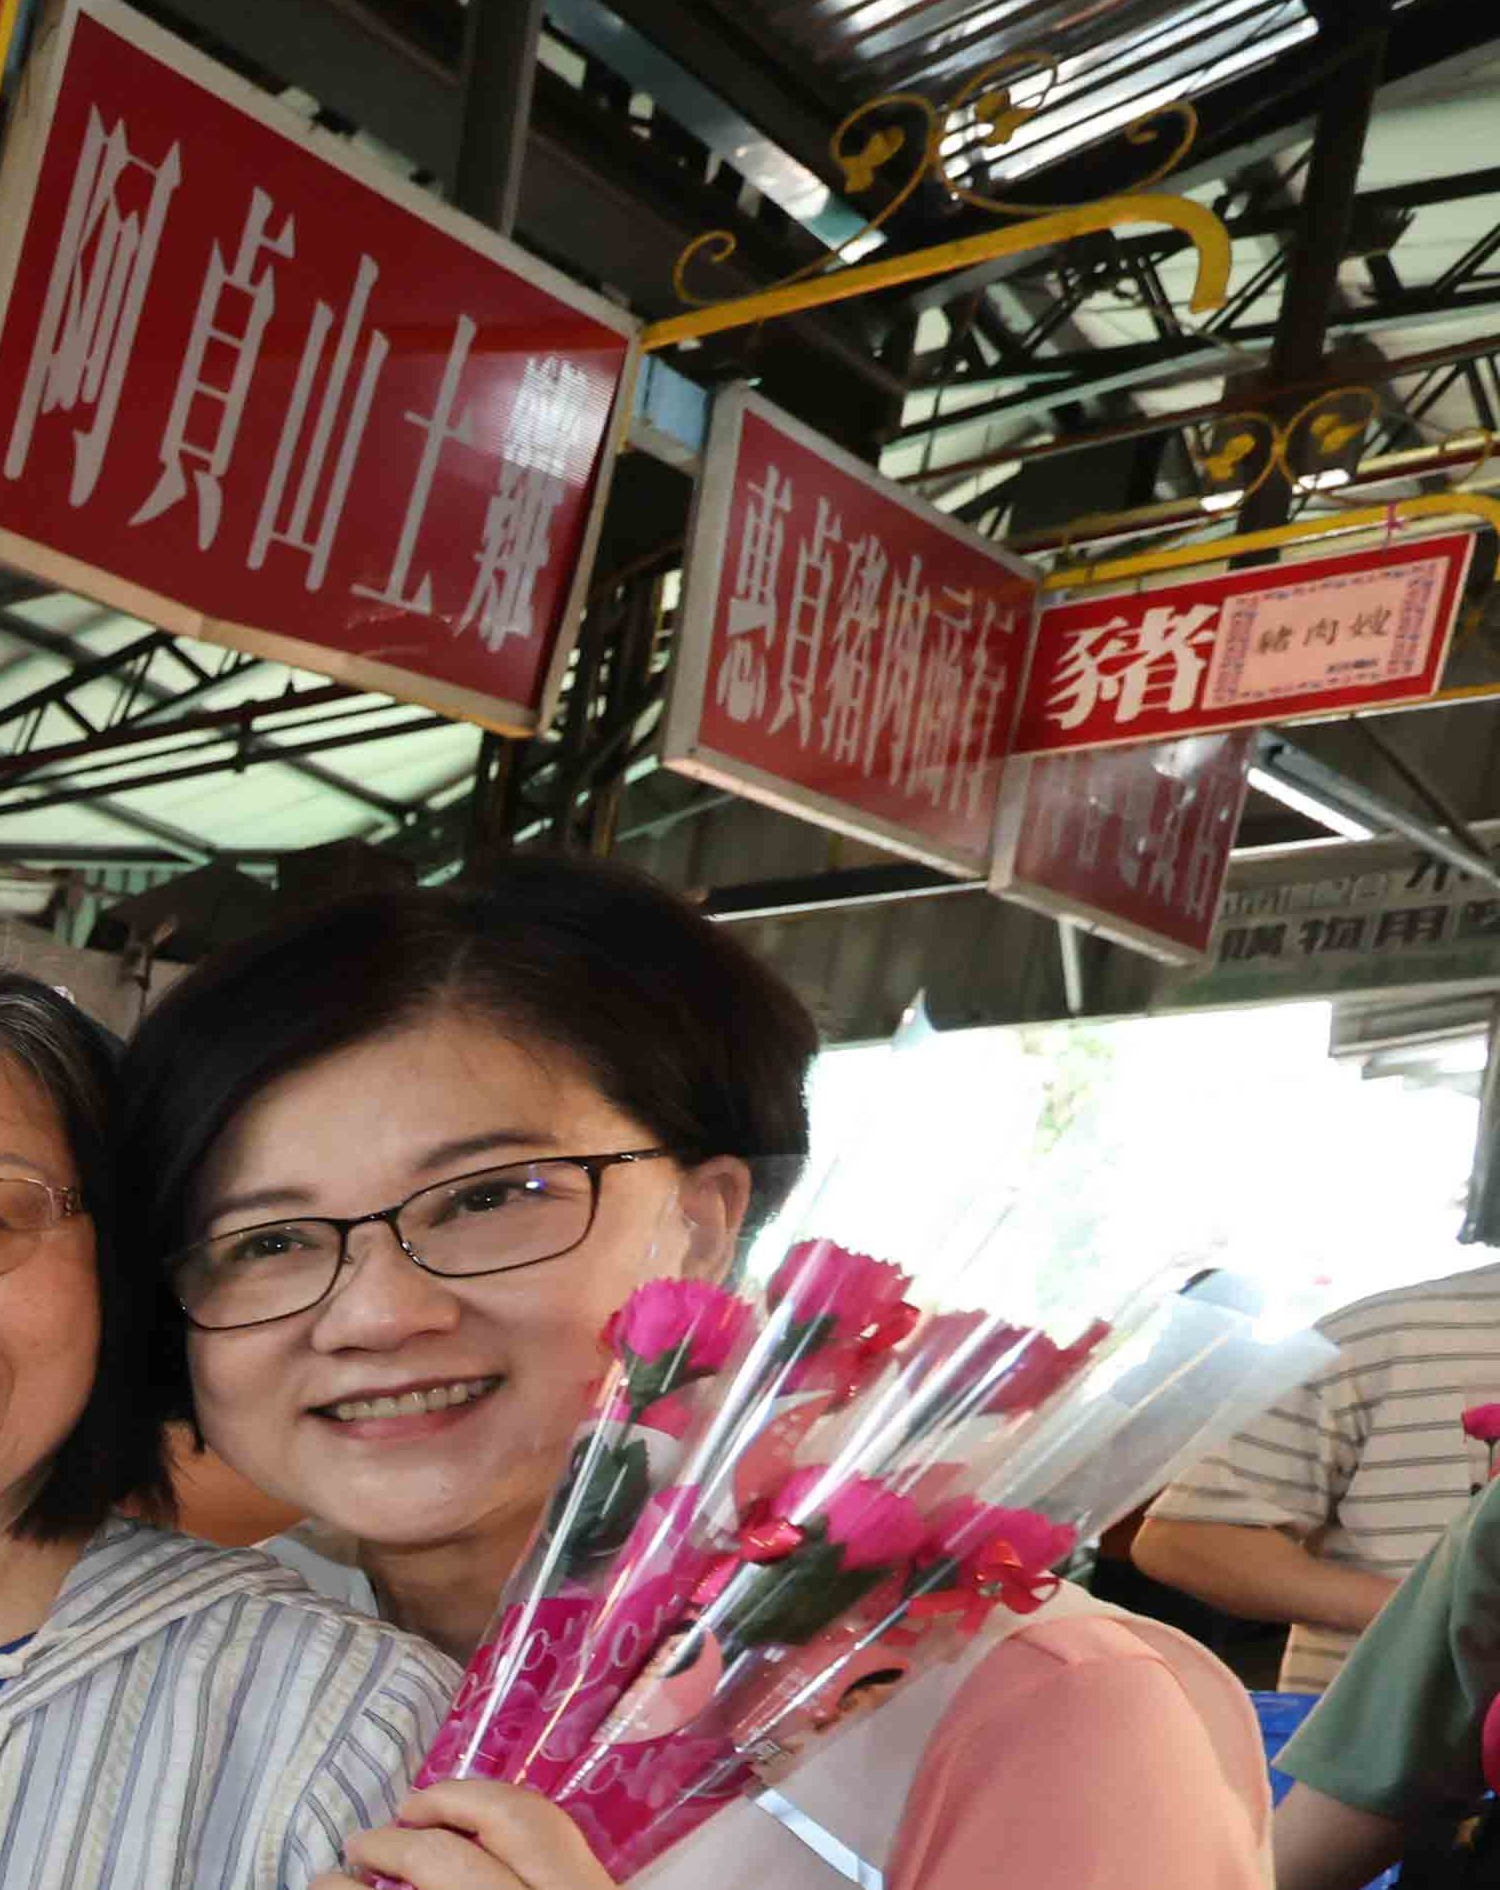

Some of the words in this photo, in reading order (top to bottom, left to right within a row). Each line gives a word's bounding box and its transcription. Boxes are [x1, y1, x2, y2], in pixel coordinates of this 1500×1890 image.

[2, 102, 592, 654] 阿貞山土雞
[1045, 605, 1220, 731] 豬
